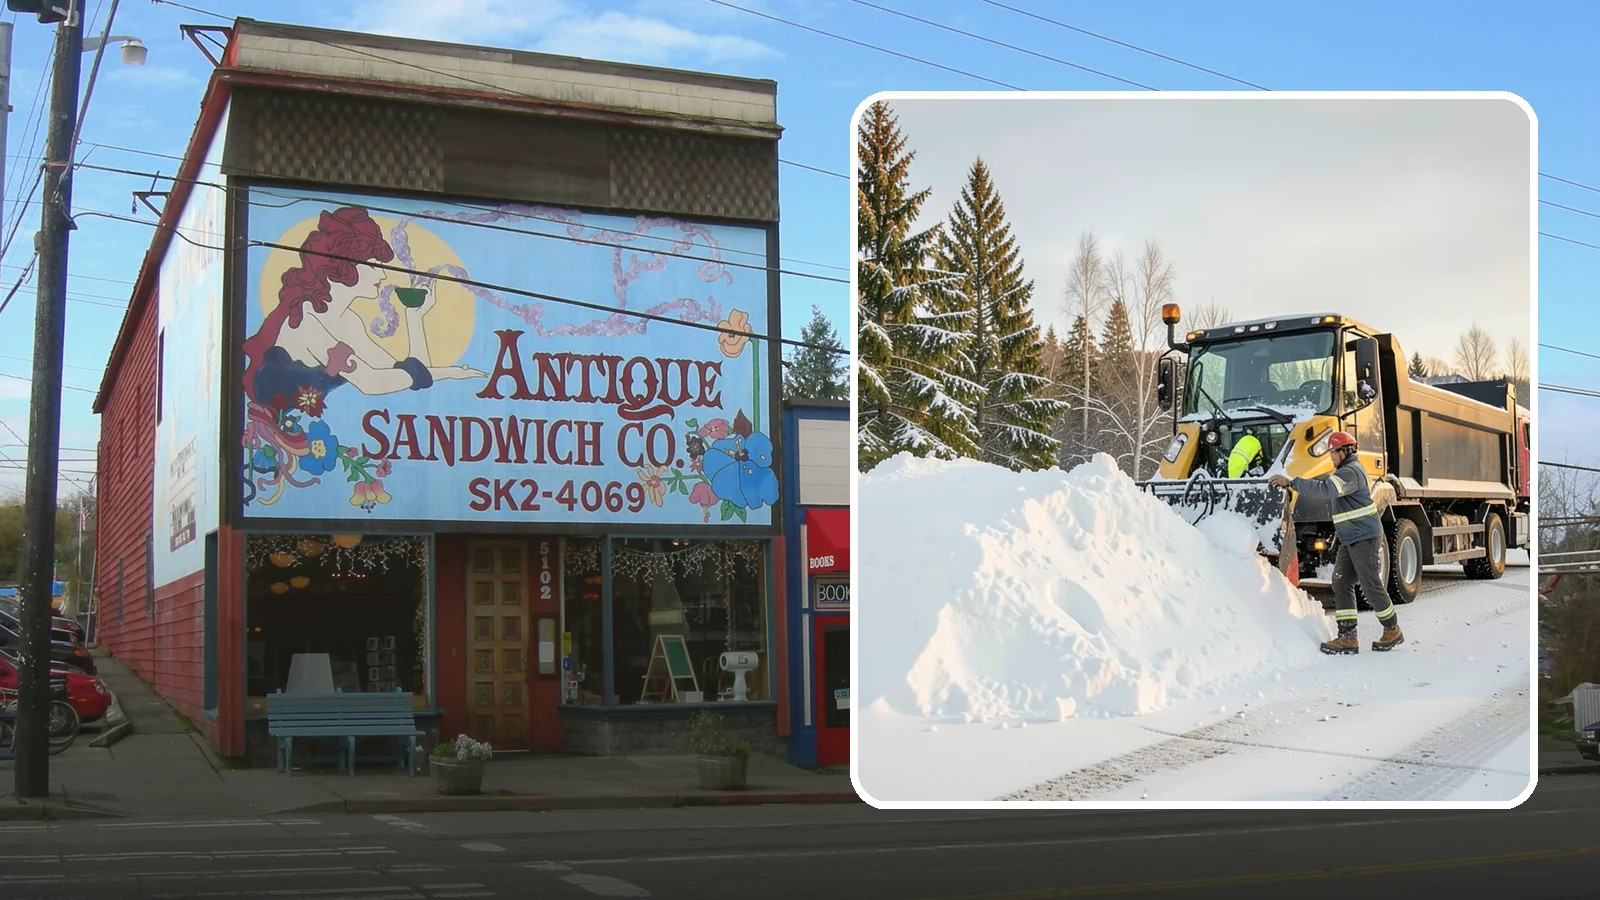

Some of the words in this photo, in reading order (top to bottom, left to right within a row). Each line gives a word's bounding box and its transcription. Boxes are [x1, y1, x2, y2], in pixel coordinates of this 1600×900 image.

[476, 329, 723, 420] ANTIQUE
[361, 408, 604, 467] SANDWICH
[617, 422, 685, 468] CO.
[468, 477, 645, 513] SK2-4069
[539, 542, 551, 599] 5102
[809, 555, 835, 569] BOOKS
